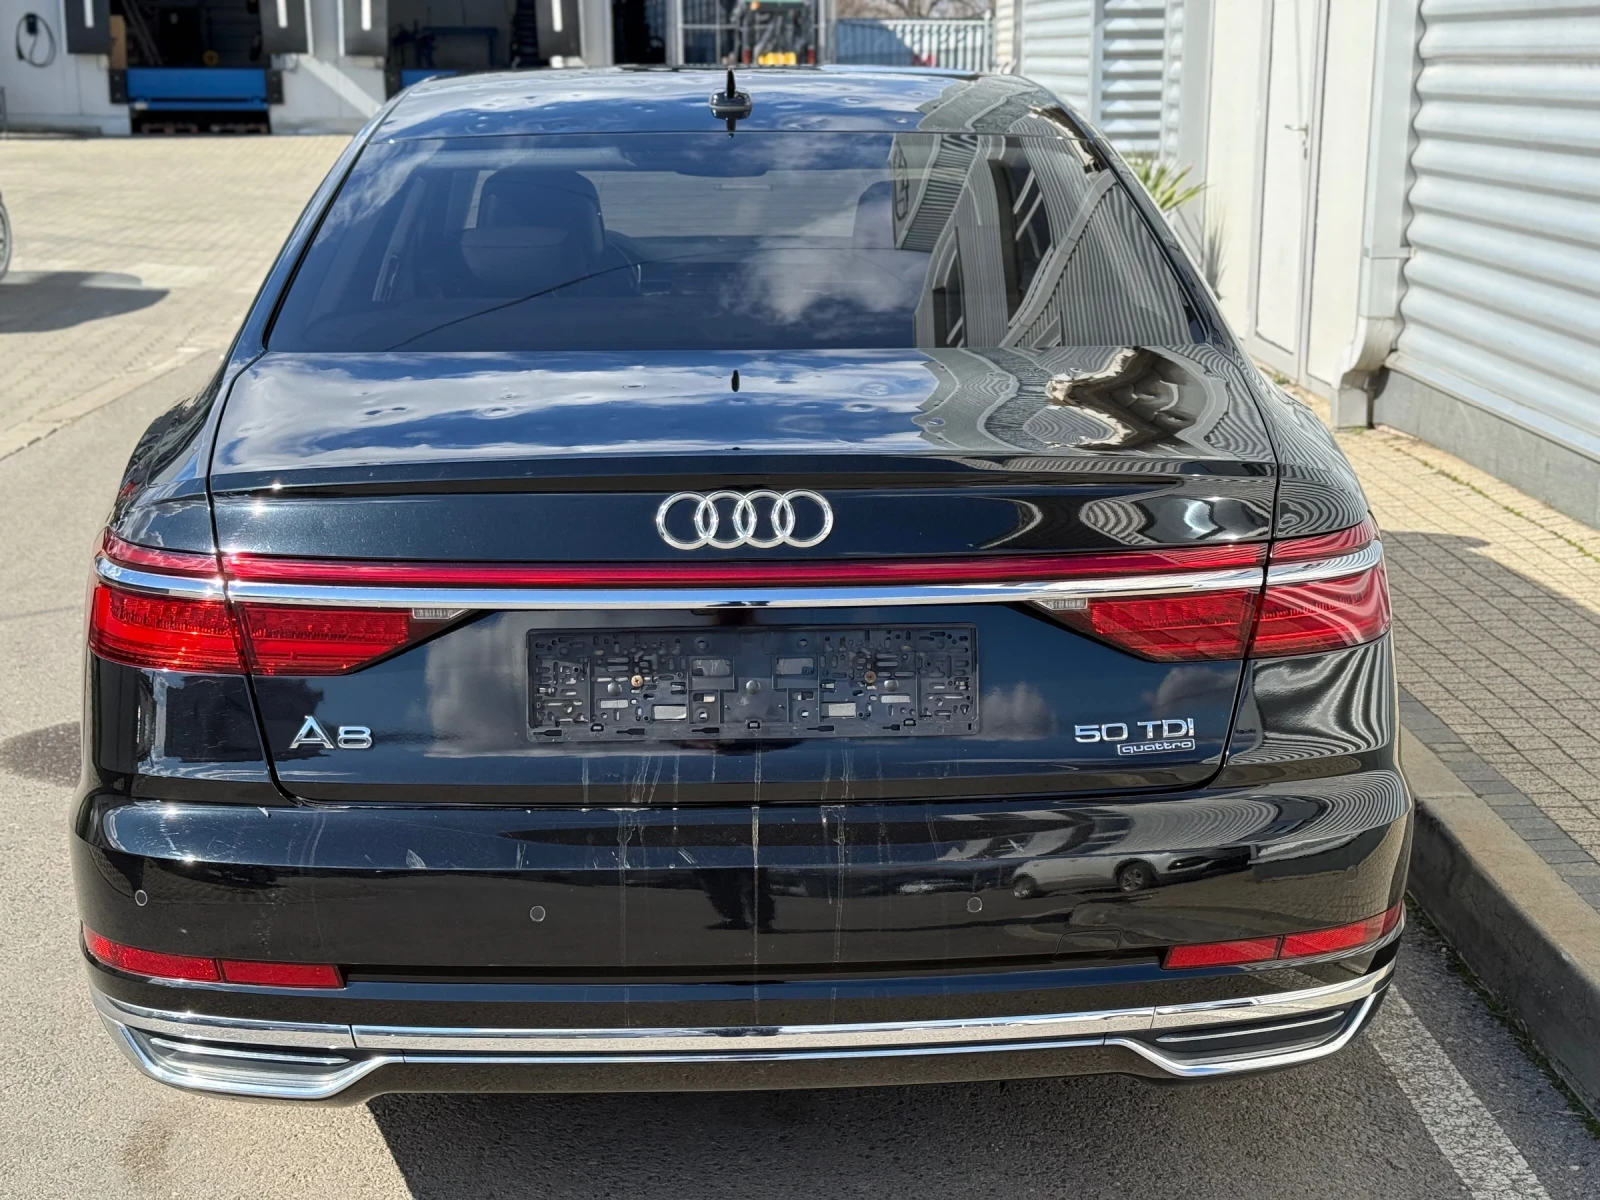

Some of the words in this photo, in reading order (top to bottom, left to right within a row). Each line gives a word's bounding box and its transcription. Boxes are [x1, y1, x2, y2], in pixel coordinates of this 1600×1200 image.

[289, 715, 372, 749] A8
[1074, 722, 1129, 743] 50
[1137, 717, 1195, 739] TDI
[1121, 740, 1192, 754] quattro
